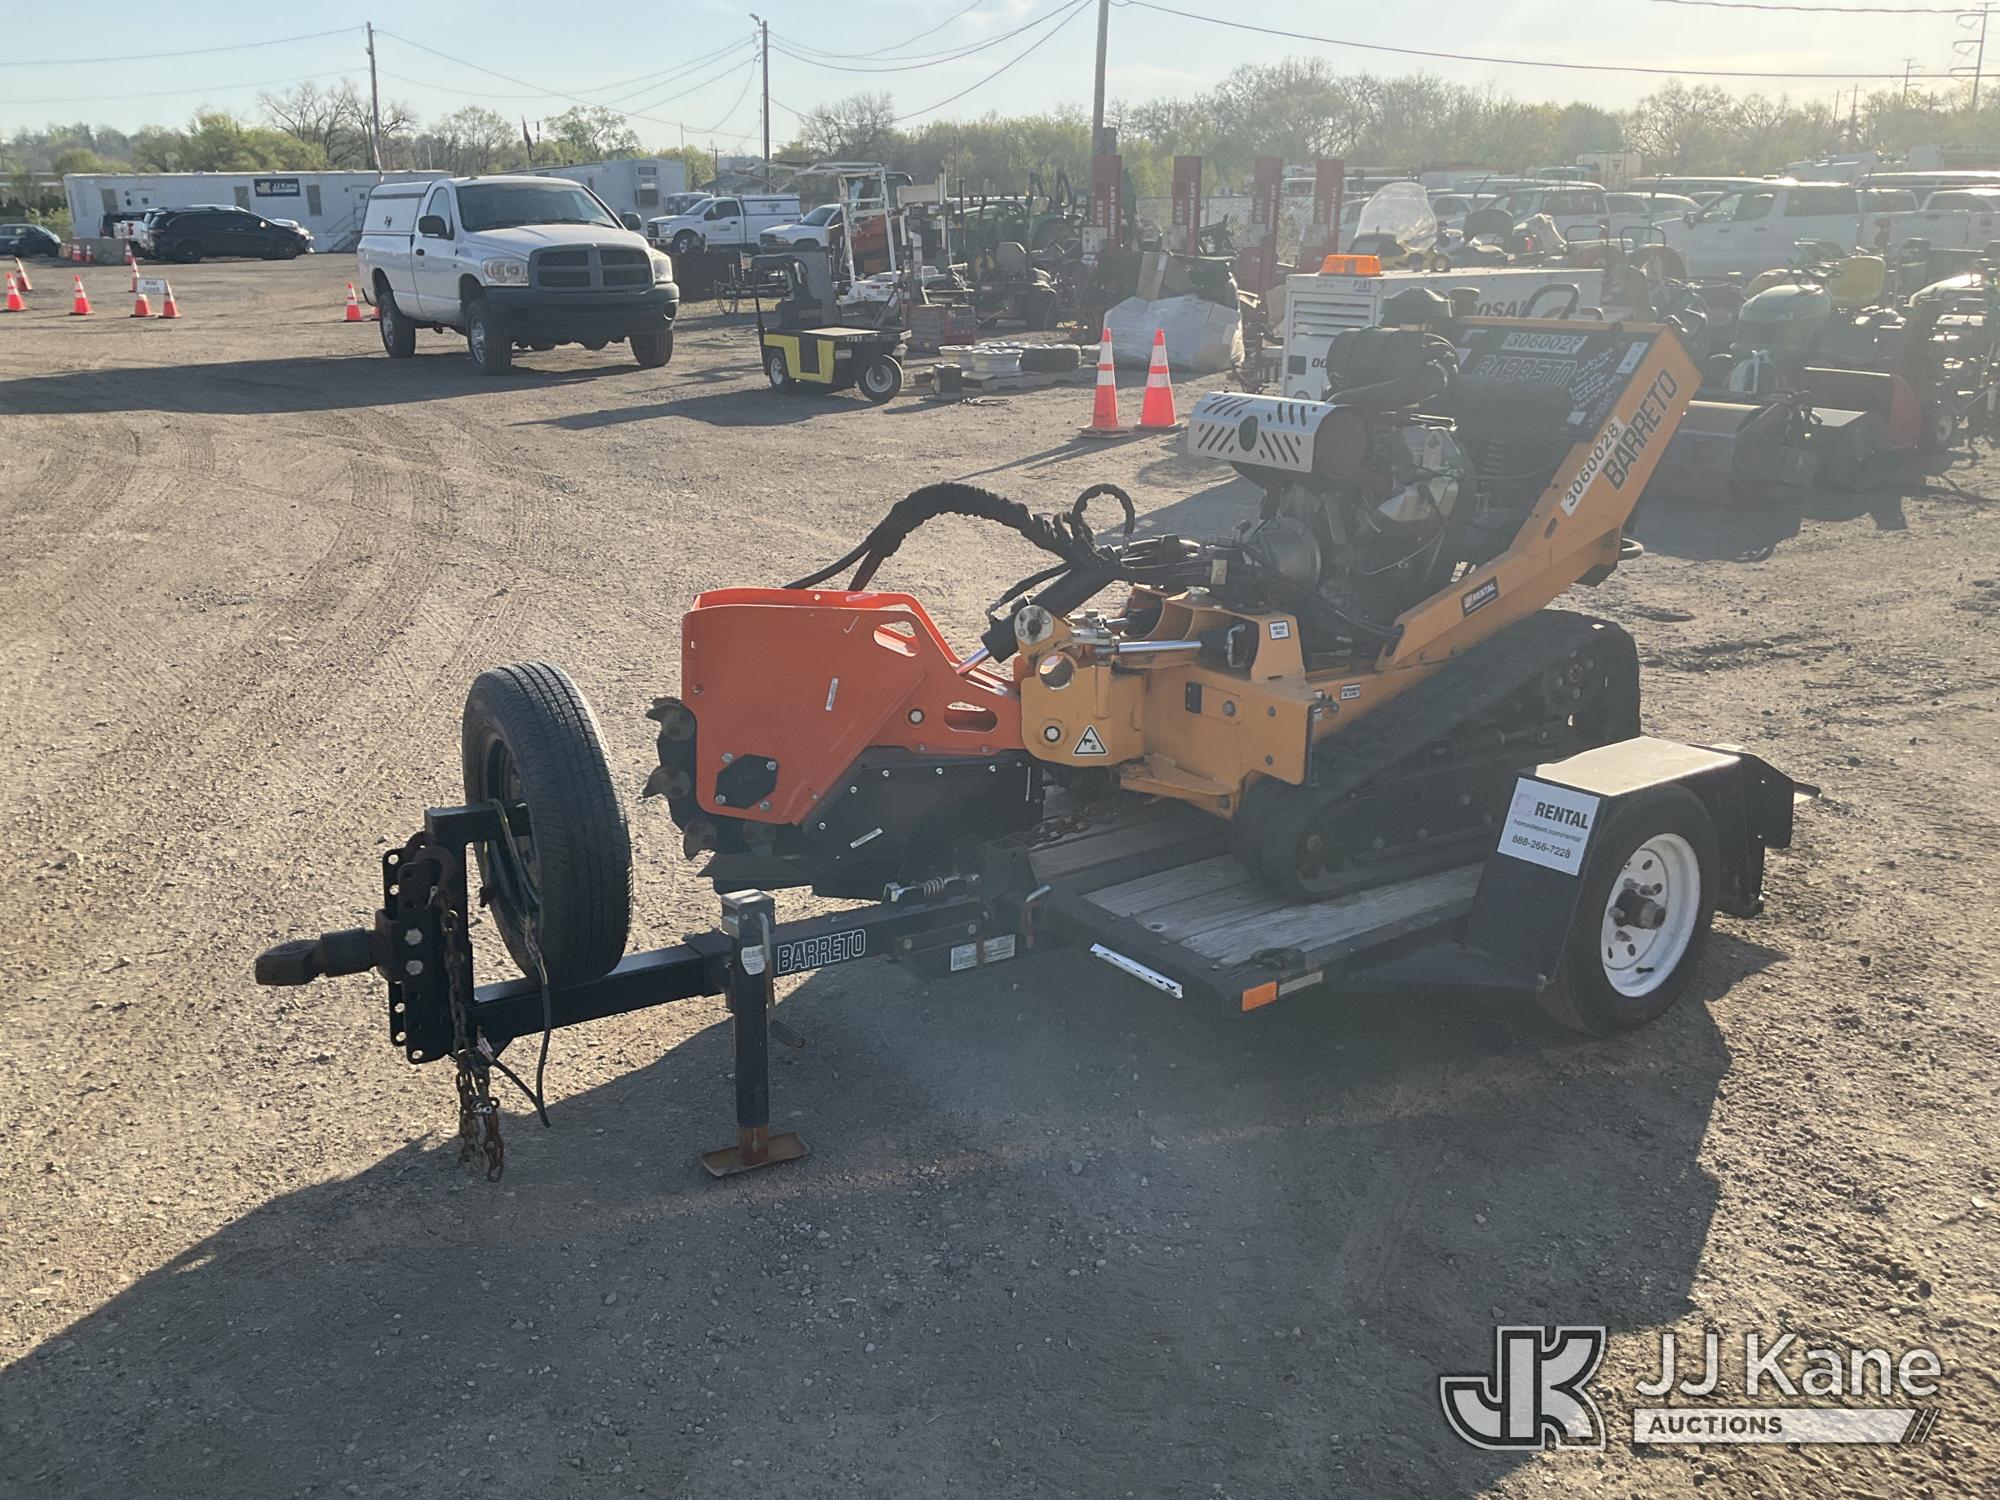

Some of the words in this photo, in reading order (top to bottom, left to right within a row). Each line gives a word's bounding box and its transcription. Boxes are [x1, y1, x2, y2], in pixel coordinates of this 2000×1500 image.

[1602, 368, 1679, 491] BARRETO
[1565, 423, 1619, 507] 3060028
[1534, 801, 1589, 829] RENTAL
[777, 928, 866, 974] BARRETO
